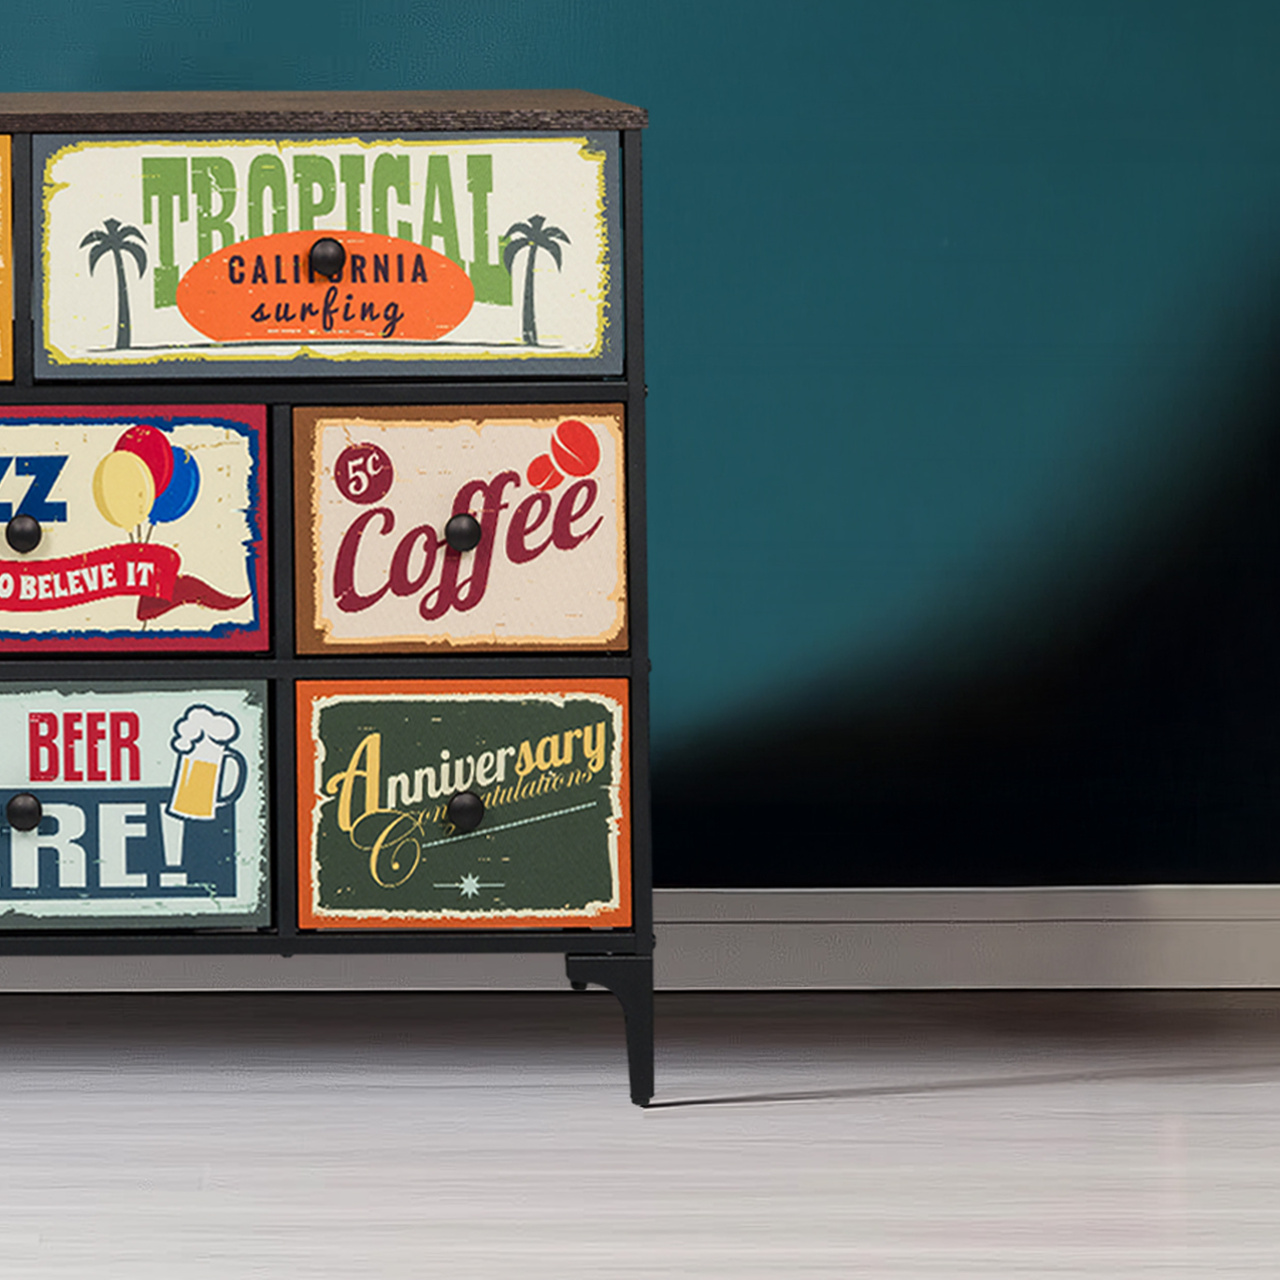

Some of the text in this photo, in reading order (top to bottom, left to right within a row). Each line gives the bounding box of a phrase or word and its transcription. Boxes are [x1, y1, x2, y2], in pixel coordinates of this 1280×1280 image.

[141, 153, 513, 308] TROPICAL
[250, 286, 405, 338] surfing
[19, 562, 118, 600] BELEVE
[126, 561, 155, 587] IT
[333, 470, 604, 621] Coffee
[28, 711, 141, 782] BEER
[326, 721, 607, 832] Anniversary
